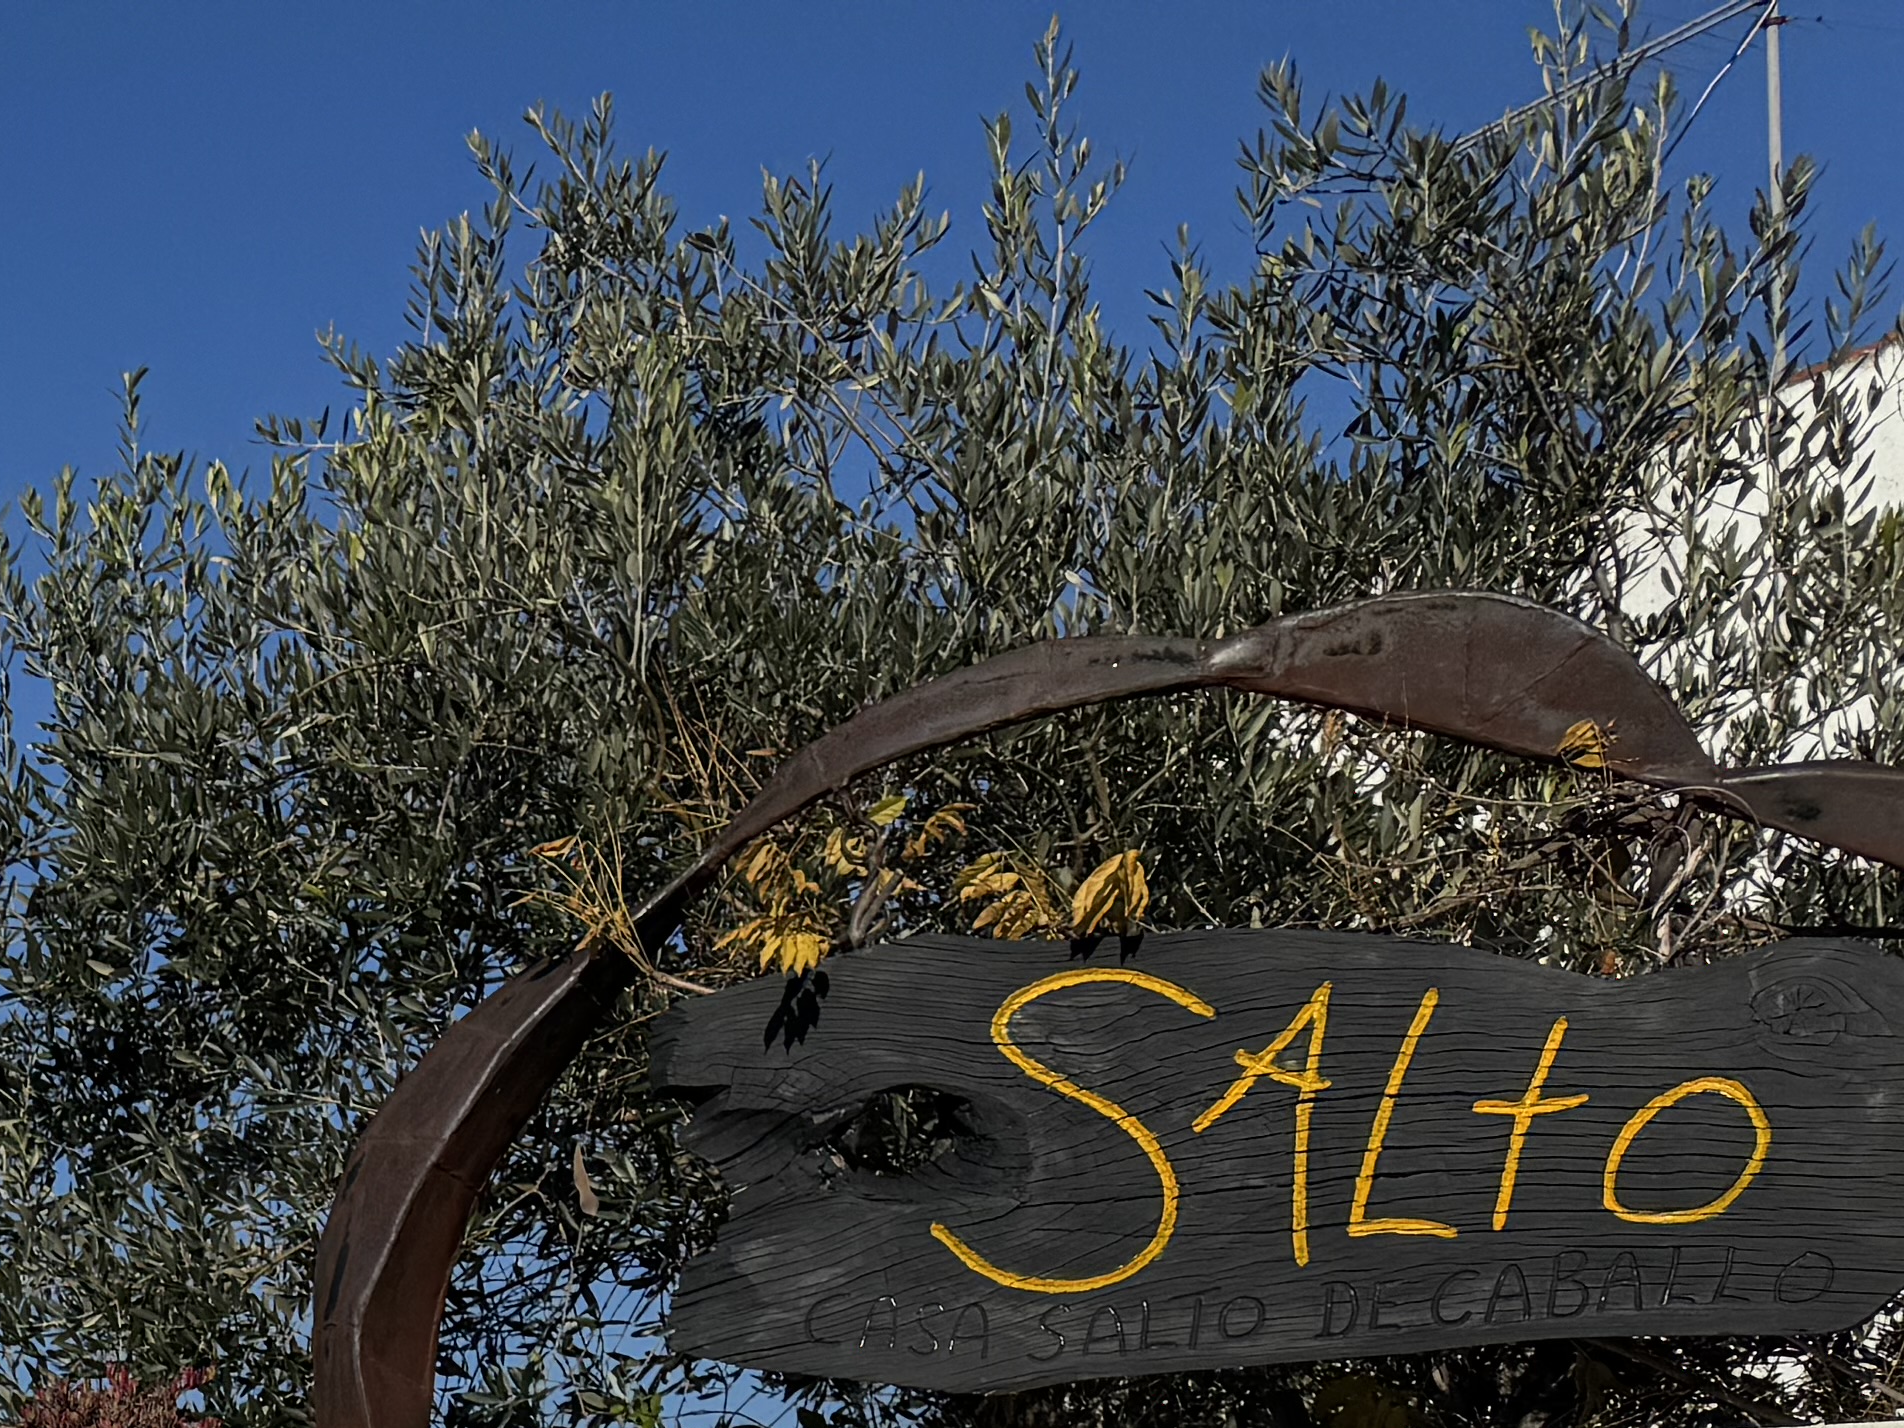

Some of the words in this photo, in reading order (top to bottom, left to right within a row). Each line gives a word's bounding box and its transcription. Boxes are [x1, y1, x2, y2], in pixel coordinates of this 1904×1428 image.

[805, 1295, 991, 1359] CASA
[1028, 1293, 1267, 1361] SALTO
[1315, 1280, 1400, 1341] DE
[1430, 1245, 1837, 1327] CABALLO
